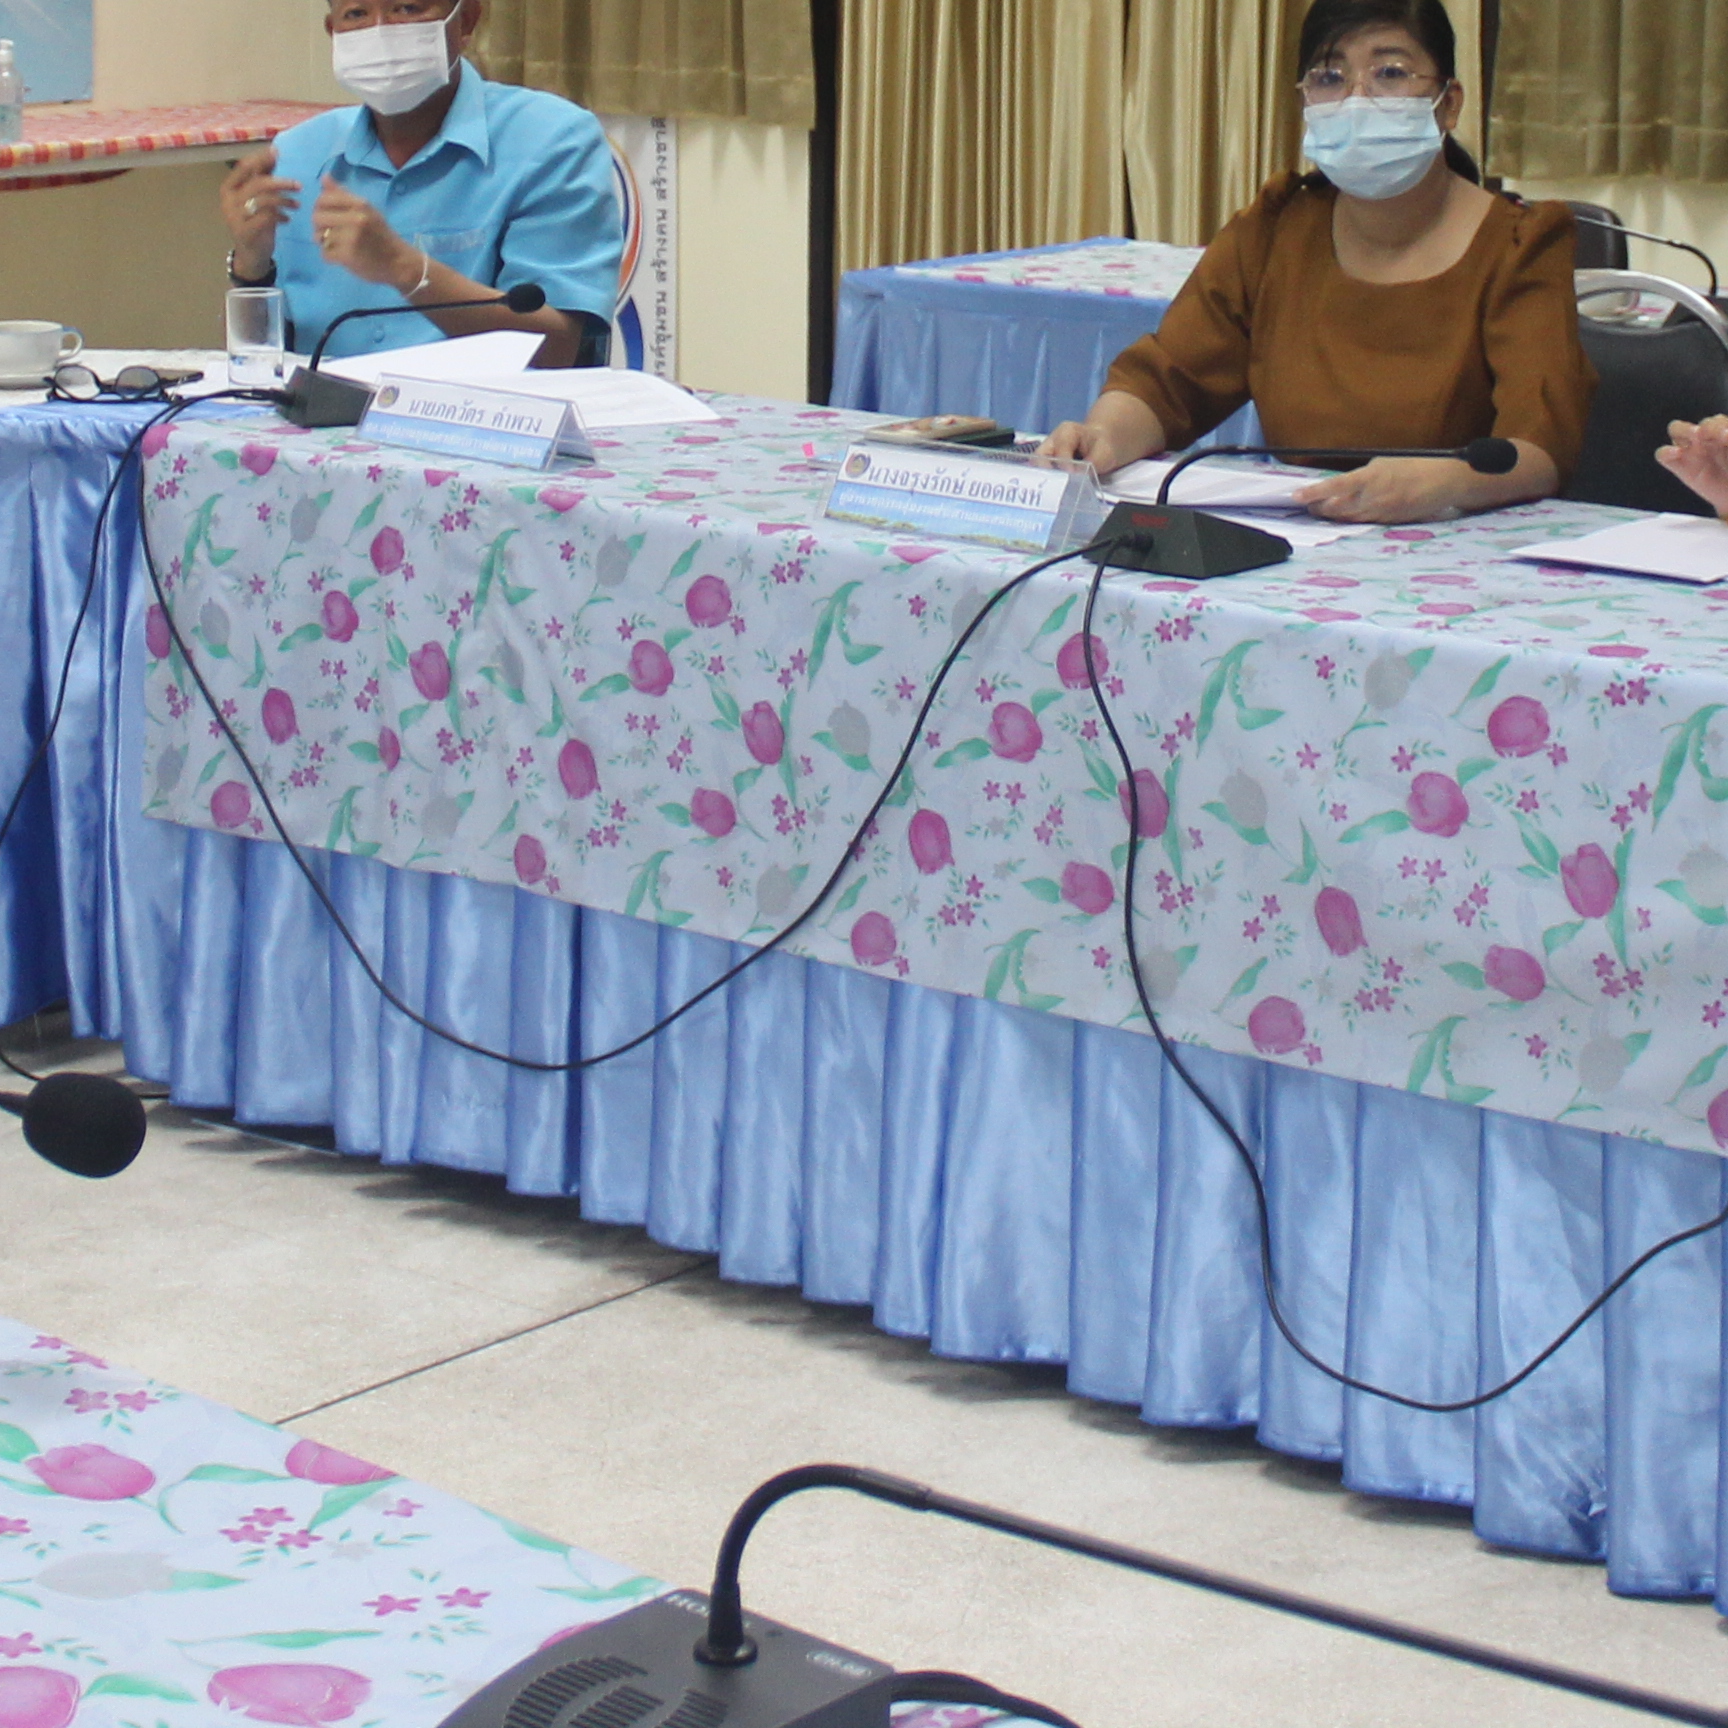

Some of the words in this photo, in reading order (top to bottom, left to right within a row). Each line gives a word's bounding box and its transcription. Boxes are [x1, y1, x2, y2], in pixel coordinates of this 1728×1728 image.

[649, 207, 669, 283] สร้างคน
[969, 476, 1047, 507] ยอดสิงห์
